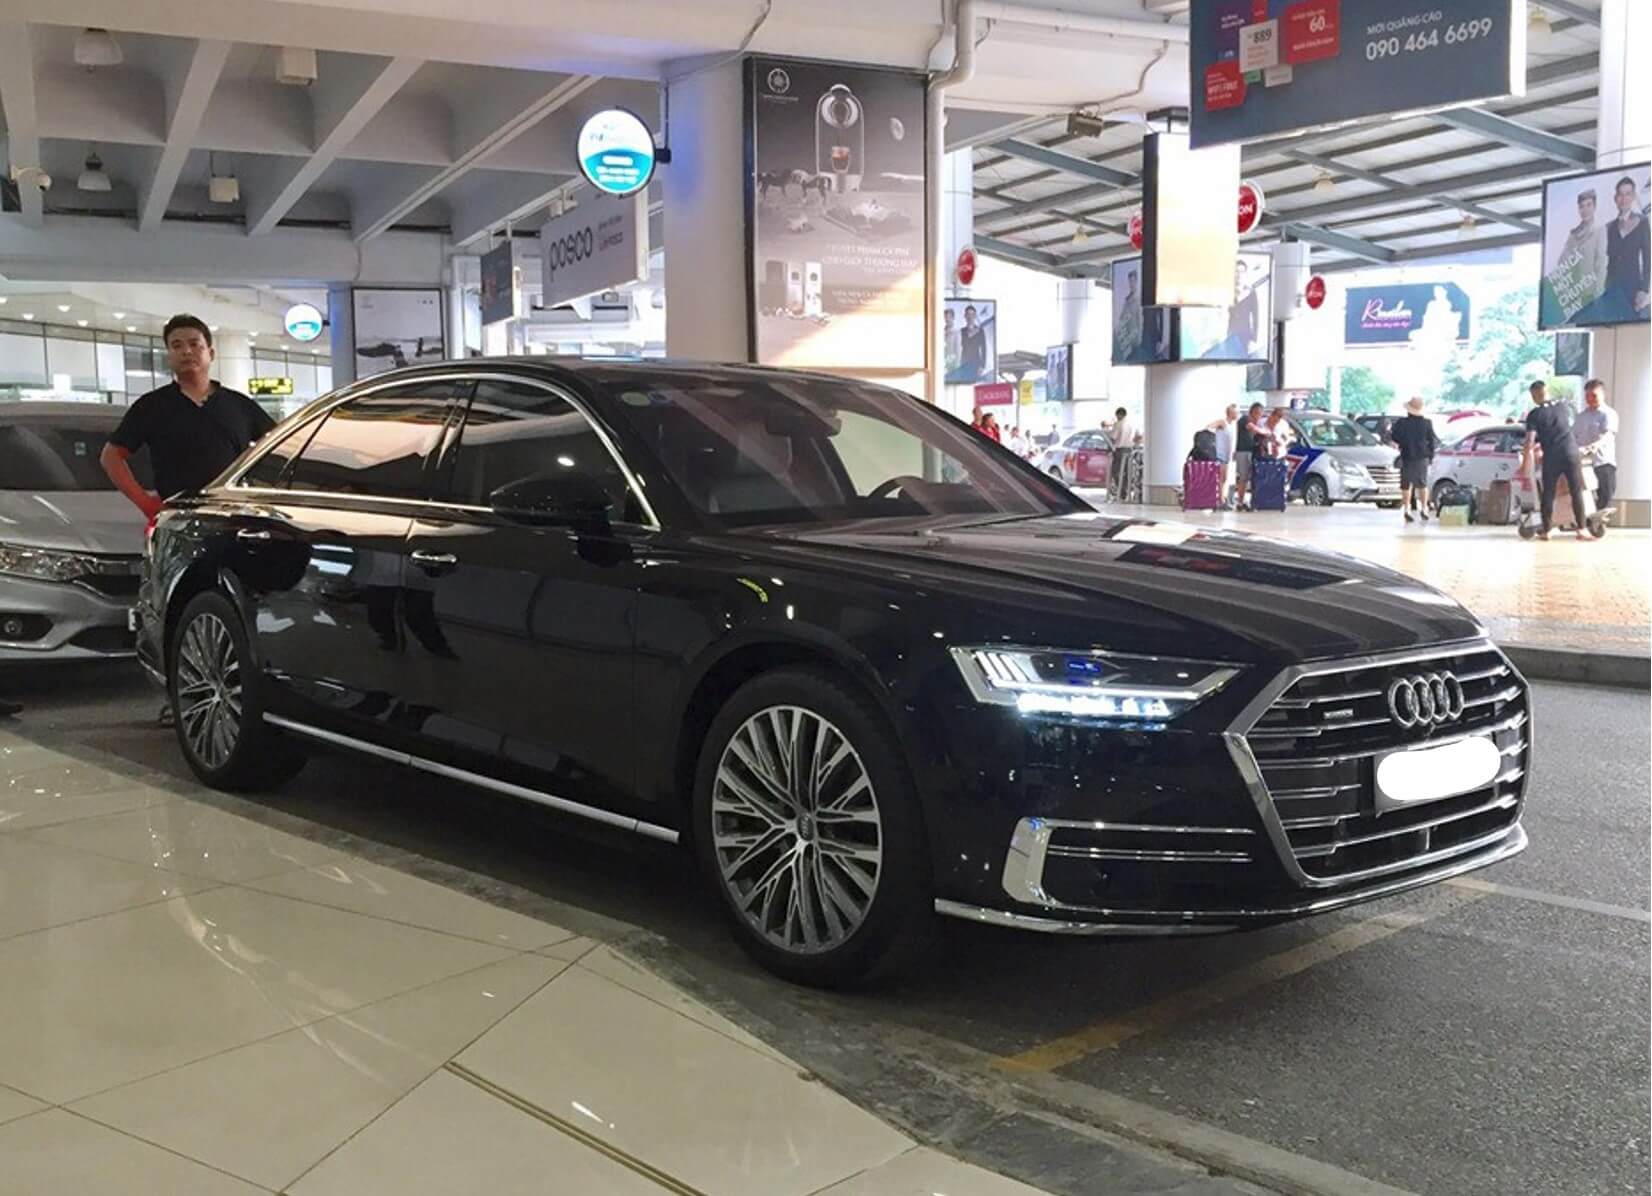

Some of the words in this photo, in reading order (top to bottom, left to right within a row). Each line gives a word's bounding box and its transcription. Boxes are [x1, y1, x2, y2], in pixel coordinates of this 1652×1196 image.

[1309, 15, 1326, 33] 60
[1366, 36, 1399, 61] 090
[1403, 28, 1439, 52] 464
[1444, 17, 1493, 45] 6699
